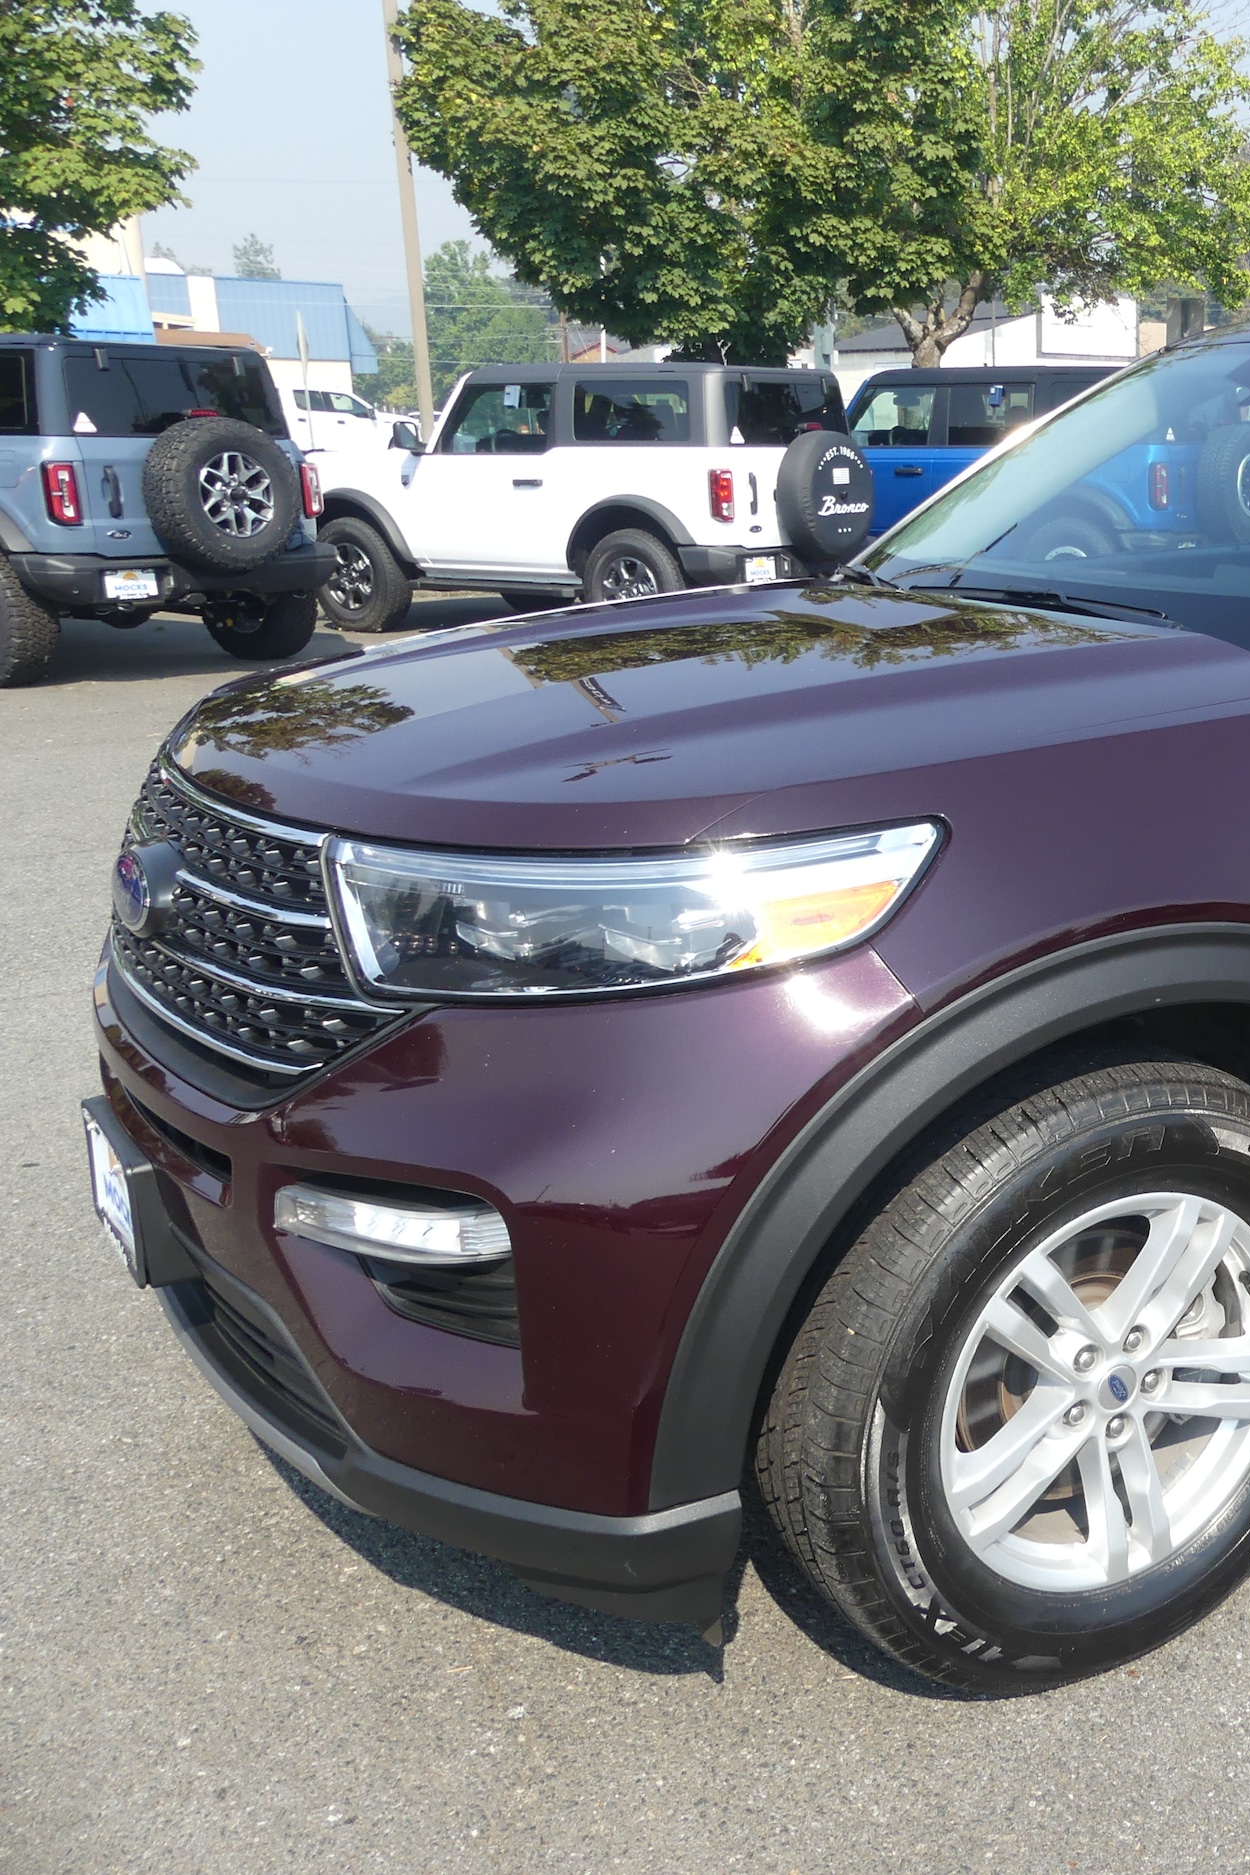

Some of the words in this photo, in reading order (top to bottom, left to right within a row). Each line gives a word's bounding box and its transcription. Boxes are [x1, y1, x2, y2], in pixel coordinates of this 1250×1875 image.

[825, 446, 840, 461] EST.
[840, 446, 856, 460] 1966
[818, 495, 869, 516] Bronco
[114, 583, 148, 591] MOCKS
[886, 1451, 901, 1507] A/S
[890, 1520, 926, 1590] CT60
